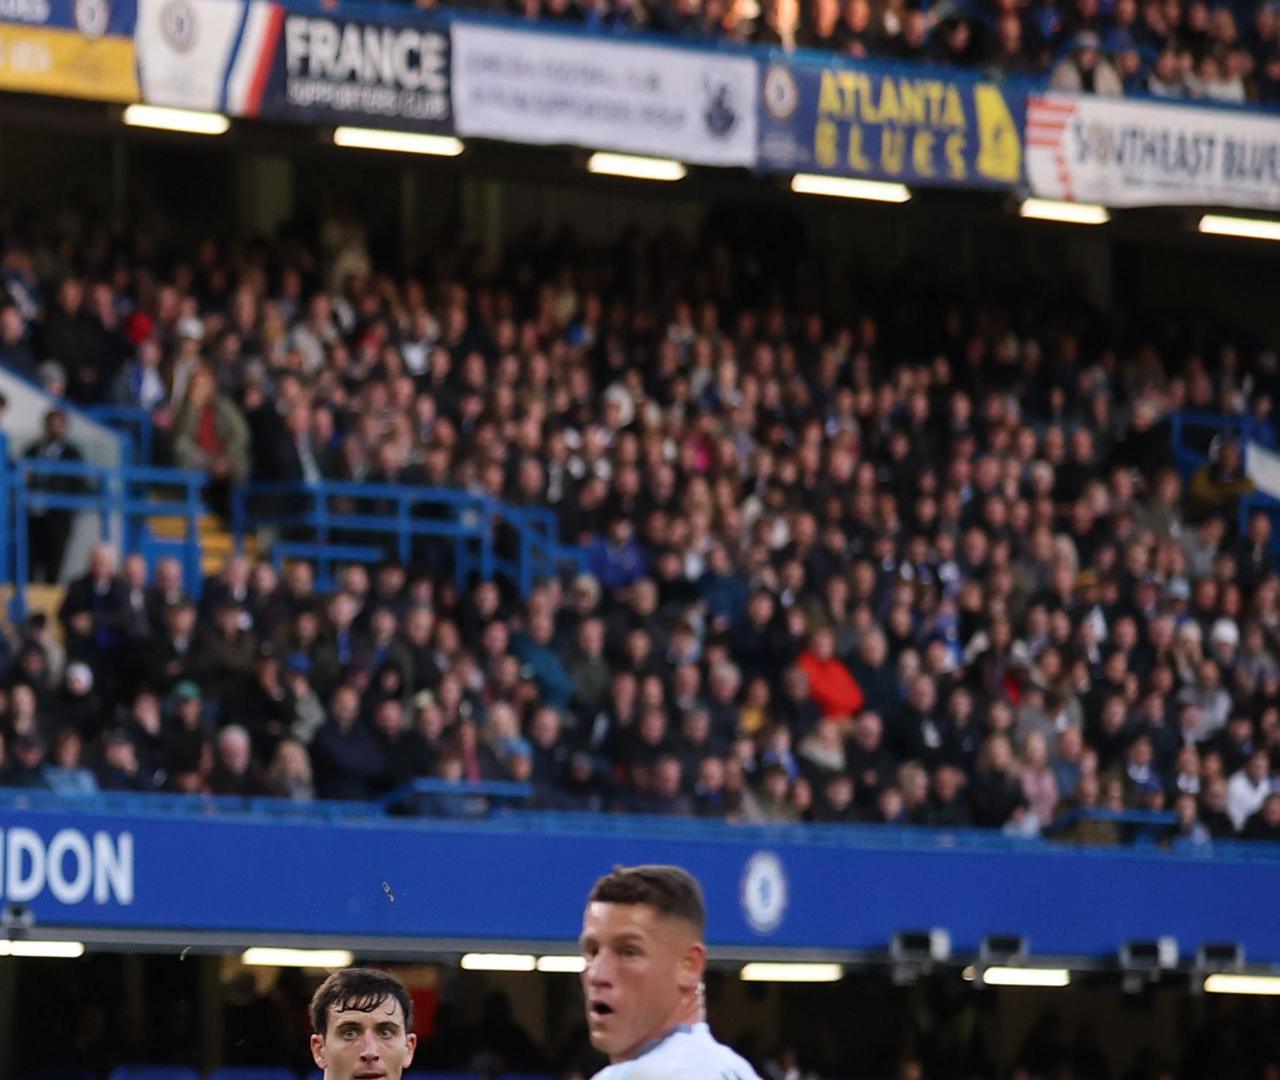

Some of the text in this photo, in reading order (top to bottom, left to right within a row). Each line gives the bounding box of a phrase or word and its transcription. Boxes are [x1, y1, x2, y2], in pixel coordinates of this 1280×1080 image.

[285, 14, 447, 91] FRANCE
[818, 68, 968, 132] ATLANTA
[814, 121, 968, 181] BLUES
